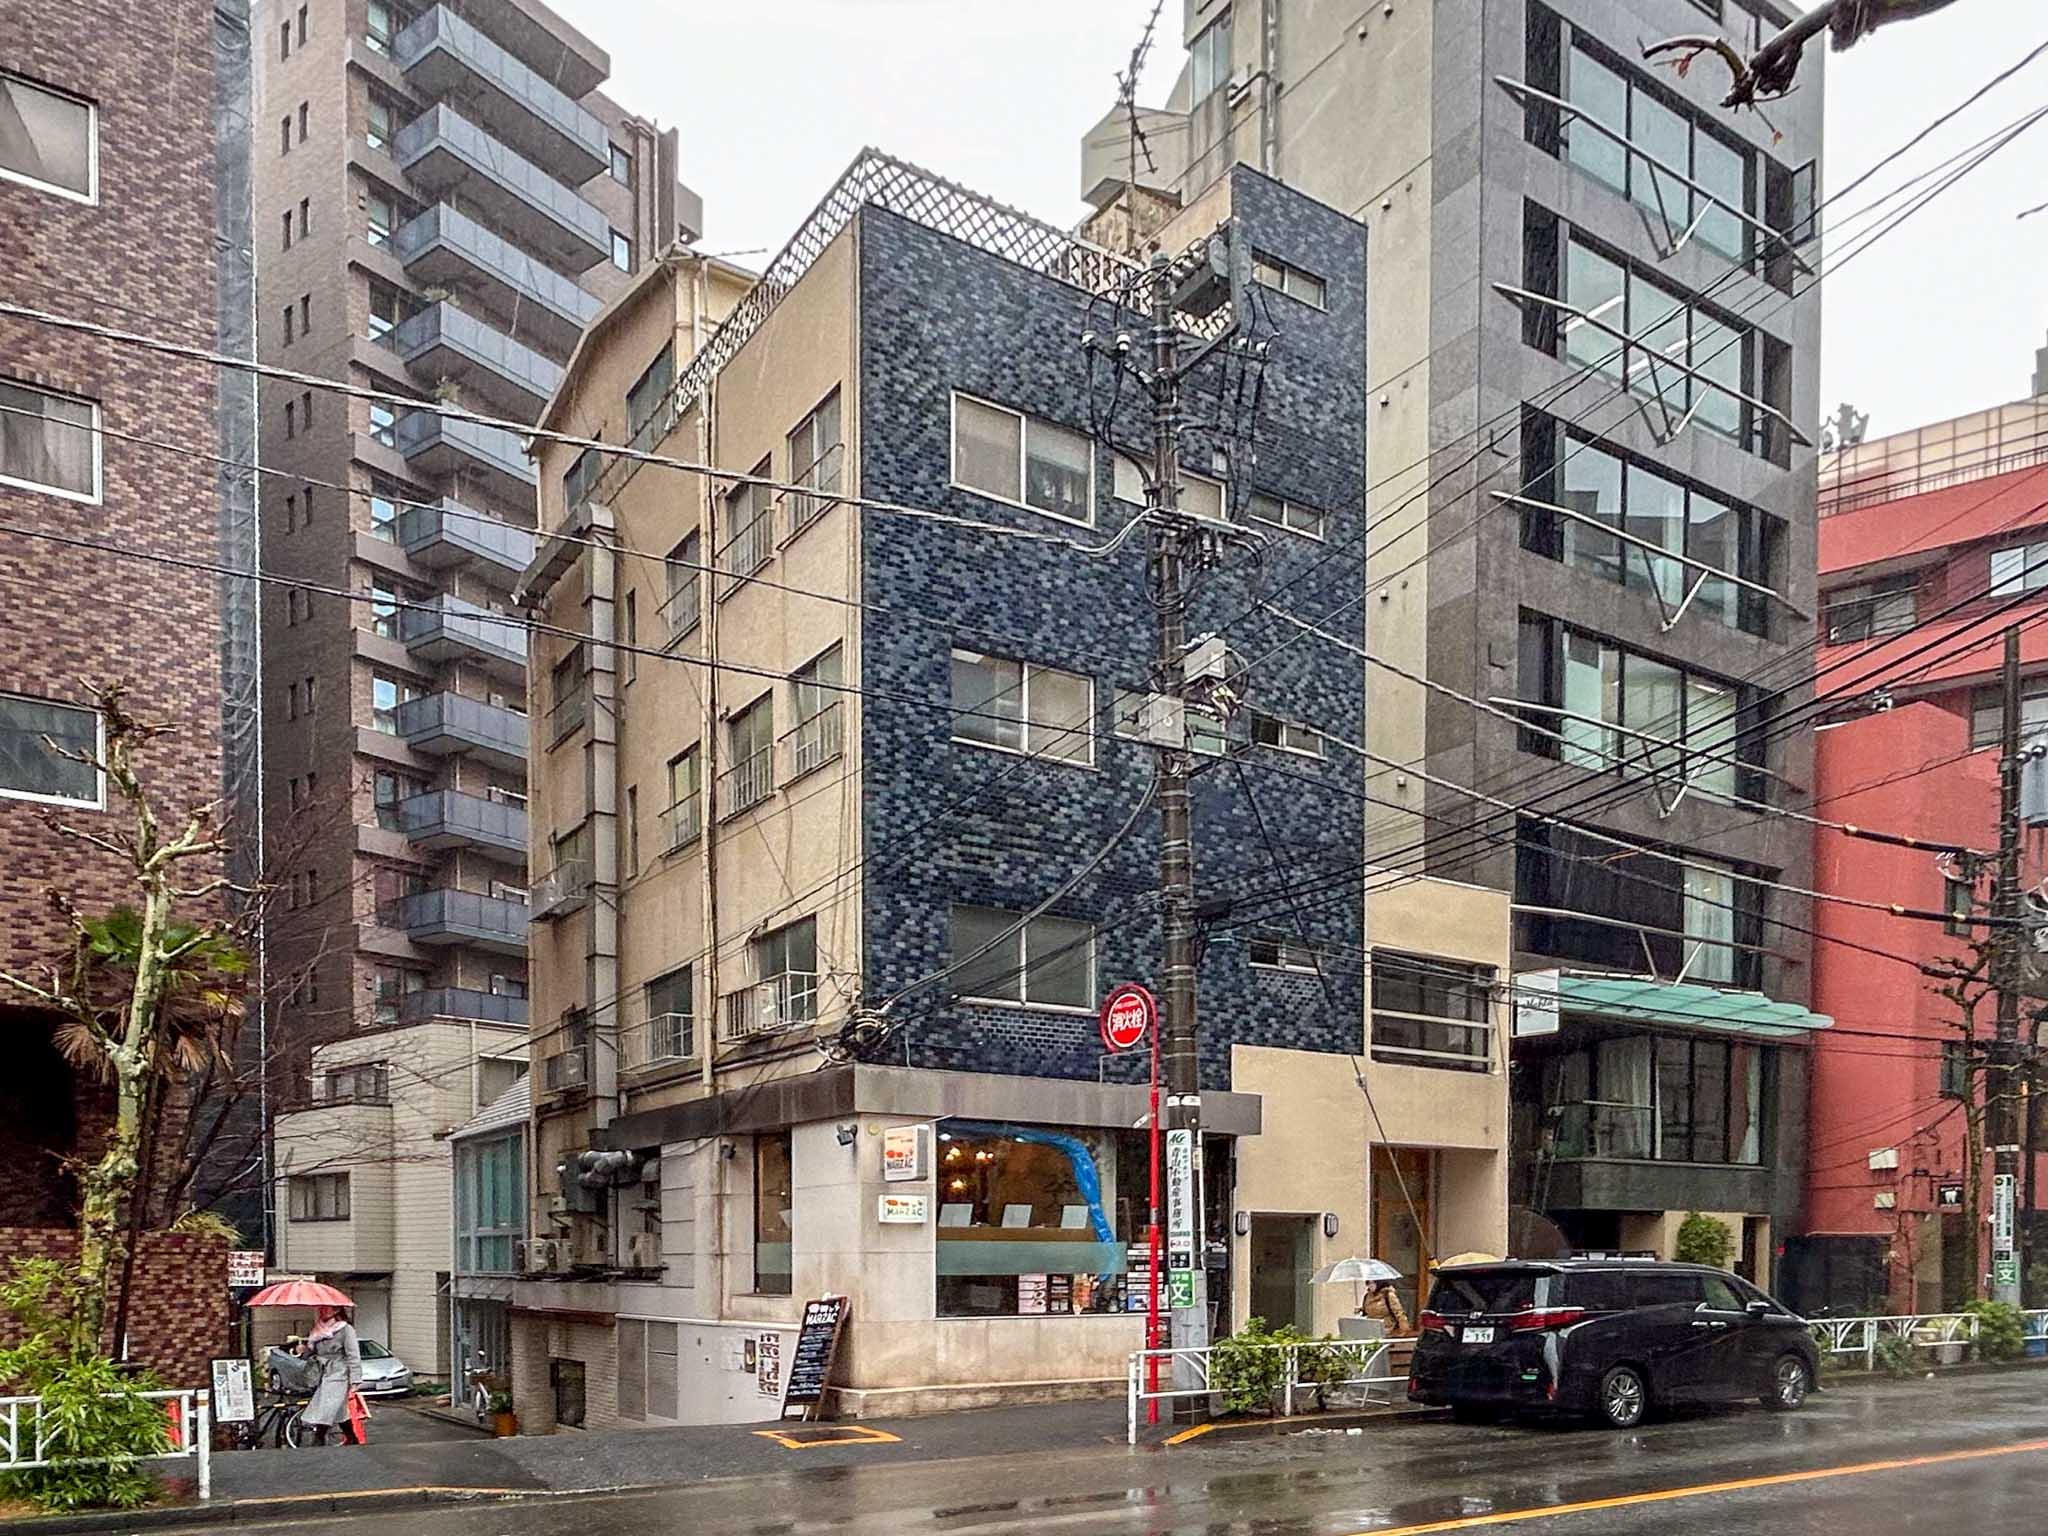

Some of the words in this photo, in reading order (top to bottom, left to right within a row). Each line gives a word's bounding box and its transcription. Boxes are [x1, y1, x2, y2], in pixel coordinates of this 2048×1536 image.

[1111, 1008, 1143, 1033] 消火栓
[1171, 1283, 1190, 1302] 文
[805, 1312, 838, 1326] MARZAC
